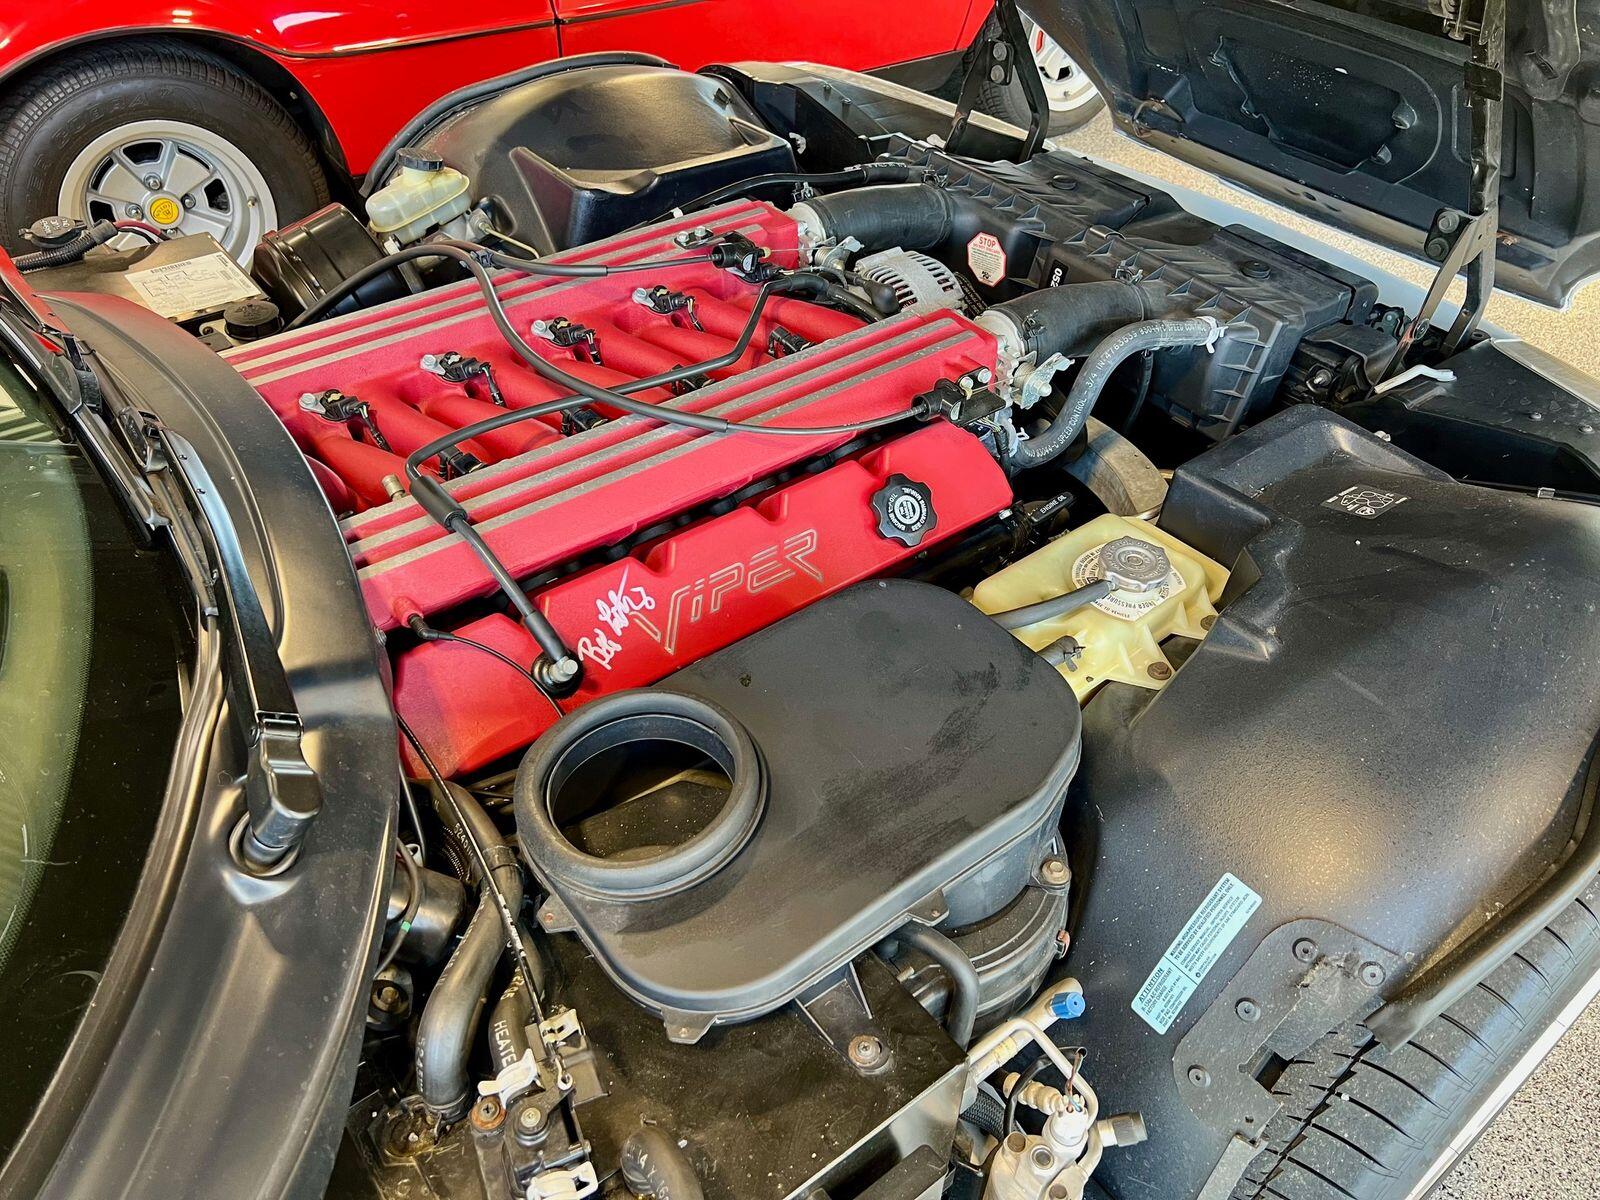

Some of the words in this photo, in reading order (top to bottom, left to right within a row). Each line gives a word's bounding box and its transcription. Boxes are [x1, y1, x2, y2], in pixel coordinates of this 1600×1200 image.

[978, 236, 996, 247] STOP
[1057, 425, 1073, 444] SPEED
[1069, 398, 1087, 426] CONTROL
[1086, 373, 1097, 388] 3/4
[1096, 359, 1105, 370] IN
[889, 493, 898, 502] OIL
[1040, 500, 1059, 514] ENGINE
[1107, 595, 1137, 609] PRESSURE
[1217, 877, 1230, 892] SYSTEM
[1136, 966, 1164, 1002] ATTENTION
[493, 1019, 517, 1068] HEATE
